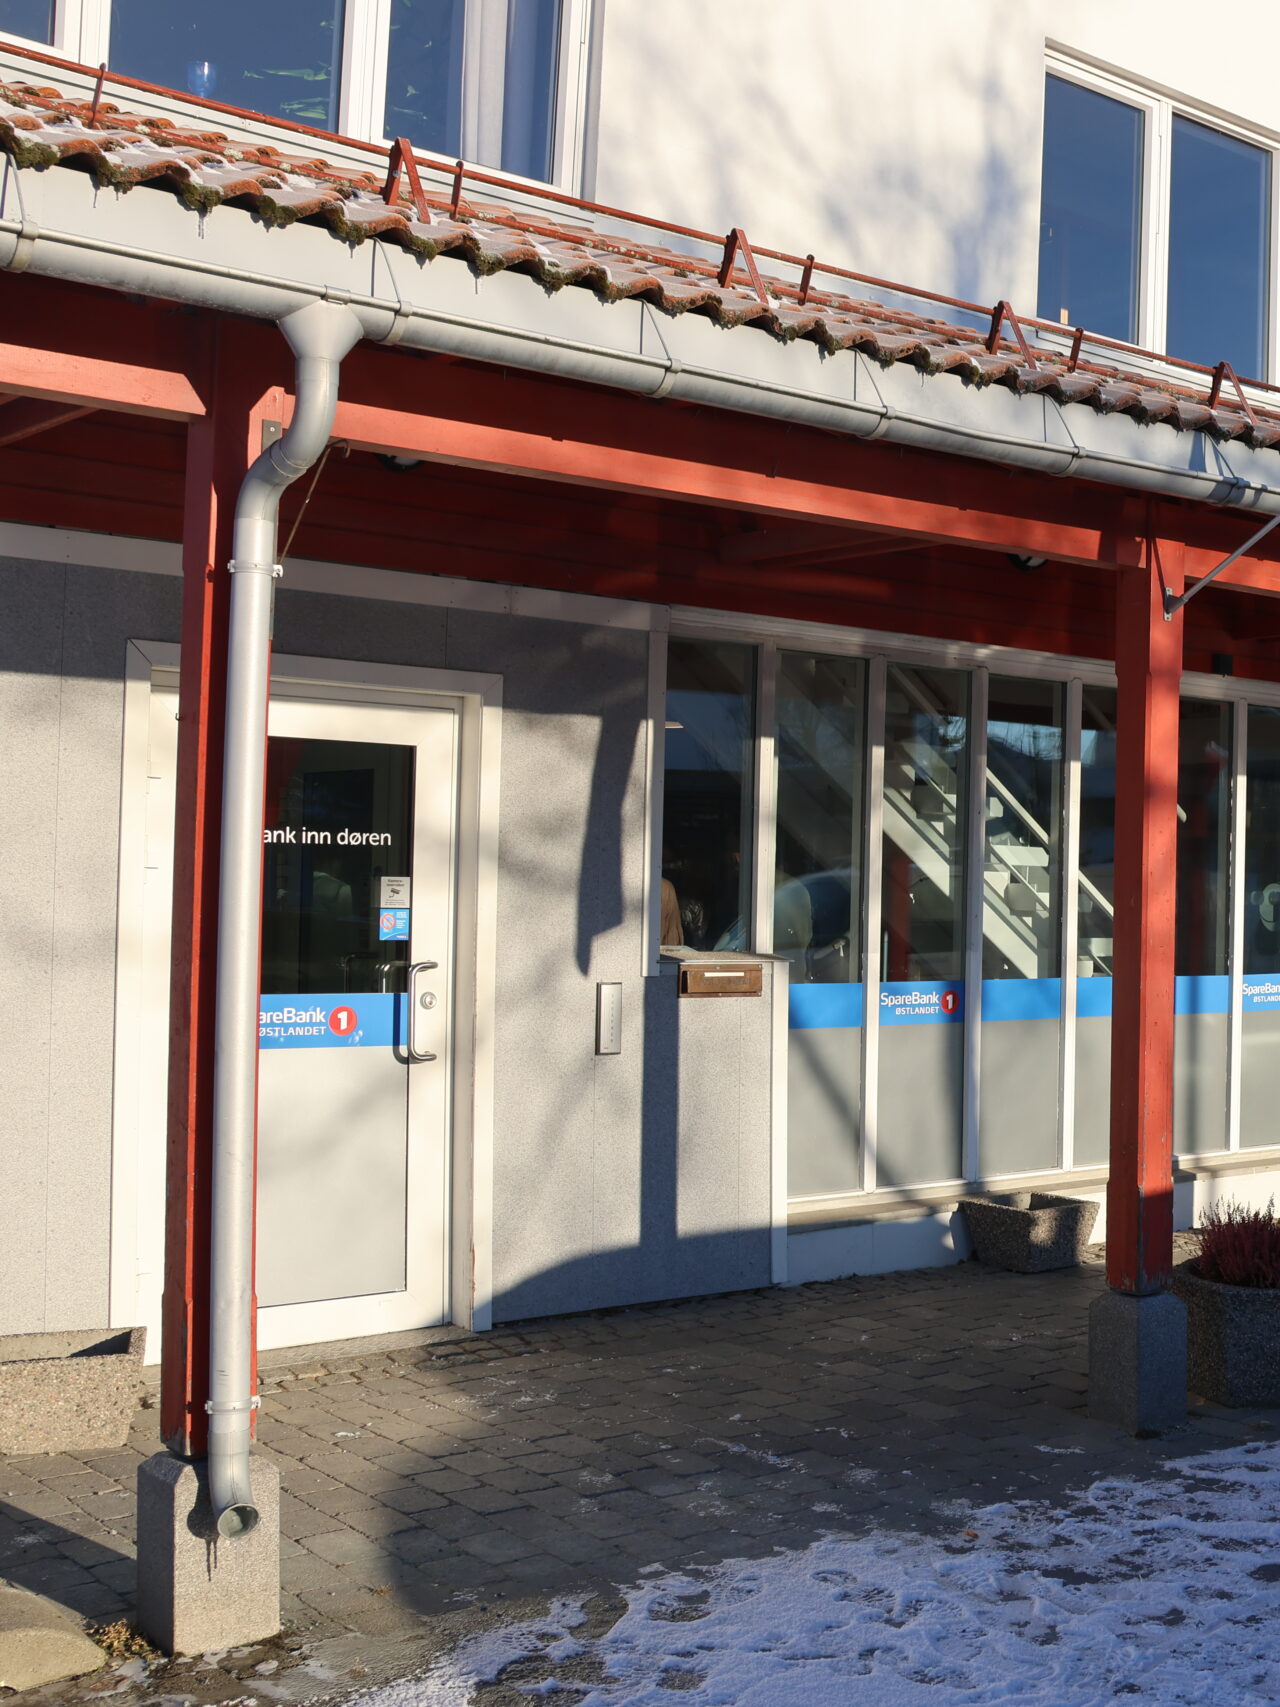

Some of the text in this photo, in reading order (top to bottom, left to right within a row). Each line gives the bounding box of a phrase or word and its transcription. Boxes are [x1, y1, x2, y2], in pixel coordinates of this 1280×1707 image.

[264, 826, 391, 846] ank inn døren
[880, 991, 940, 1008] SpareBank
[259, 1007, 348, 1030] areBank 1
[895, 1006, 940, 1015] ØSTLANDET
[259, 1026, 326, 1037] ØSTLANDET
